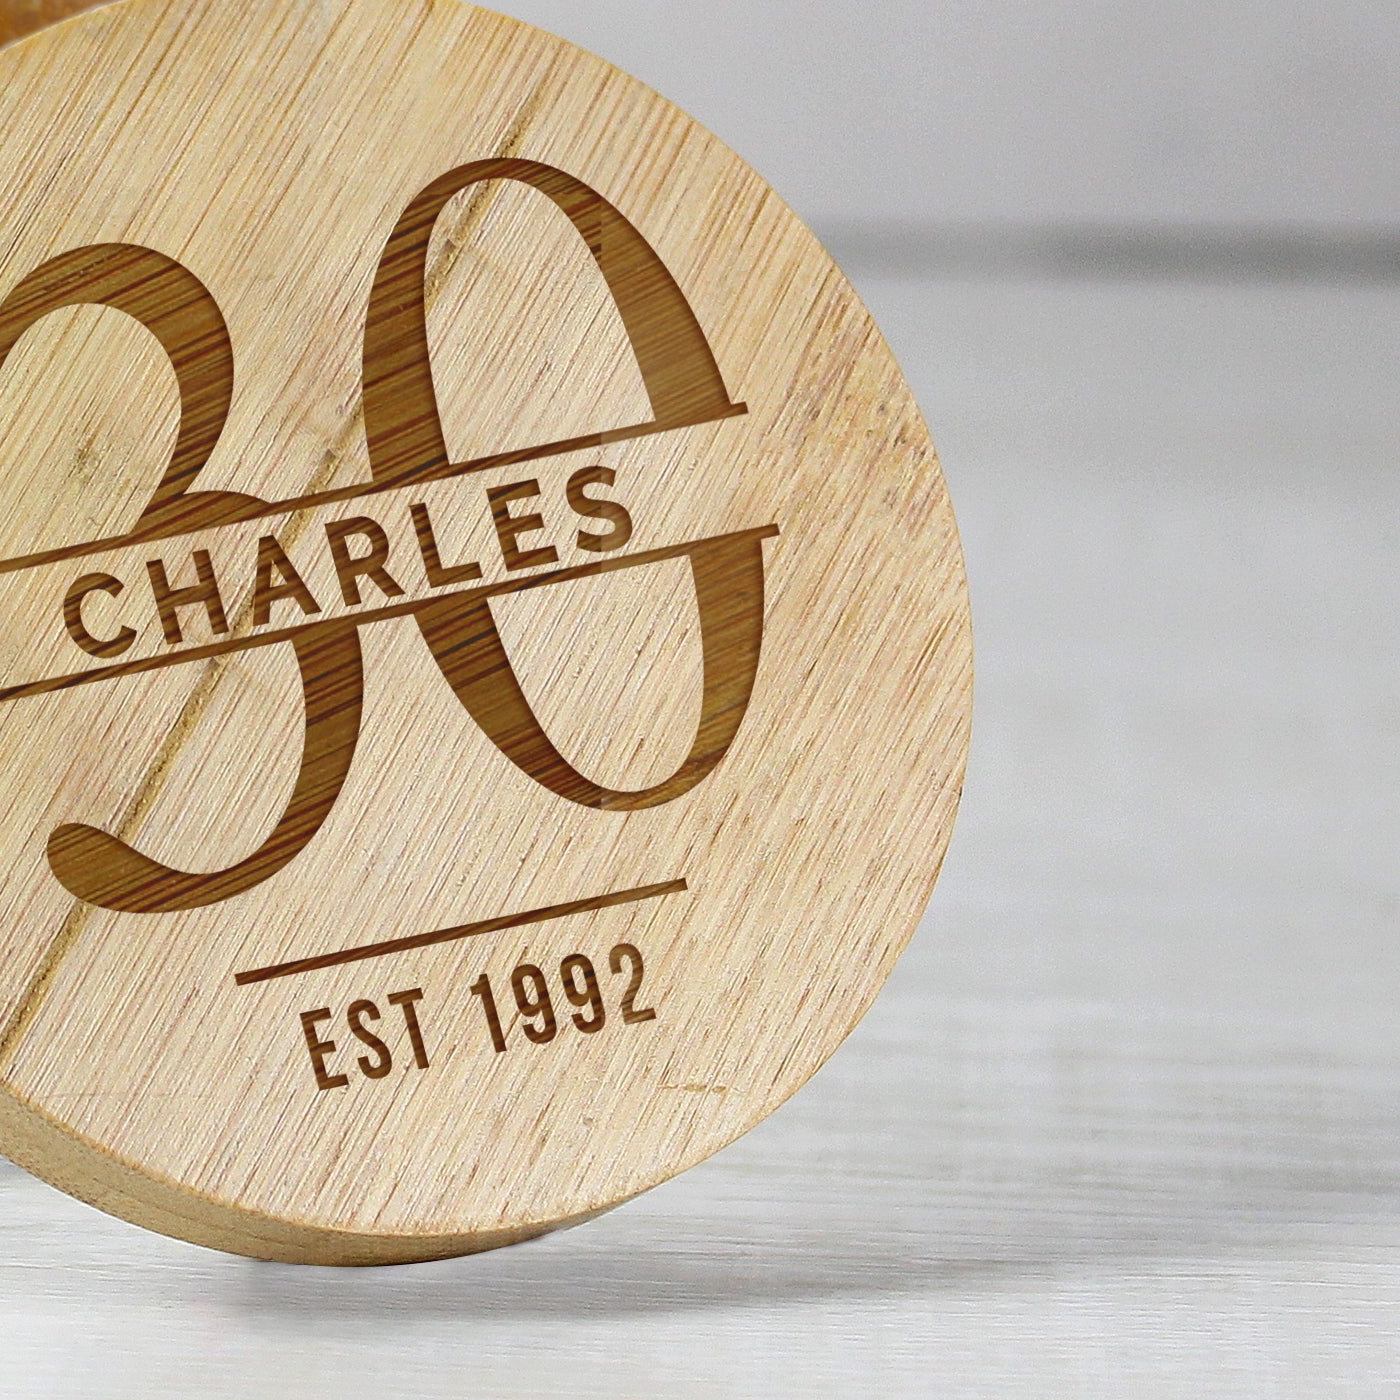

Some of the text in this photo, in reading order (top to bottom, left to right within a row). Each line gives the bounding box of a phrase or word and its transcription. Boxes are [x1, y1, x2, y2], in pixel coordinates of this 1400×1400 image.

[62, 465, 635, 659] CHARLES
[299, 942, 658, 1091] EST 1992
